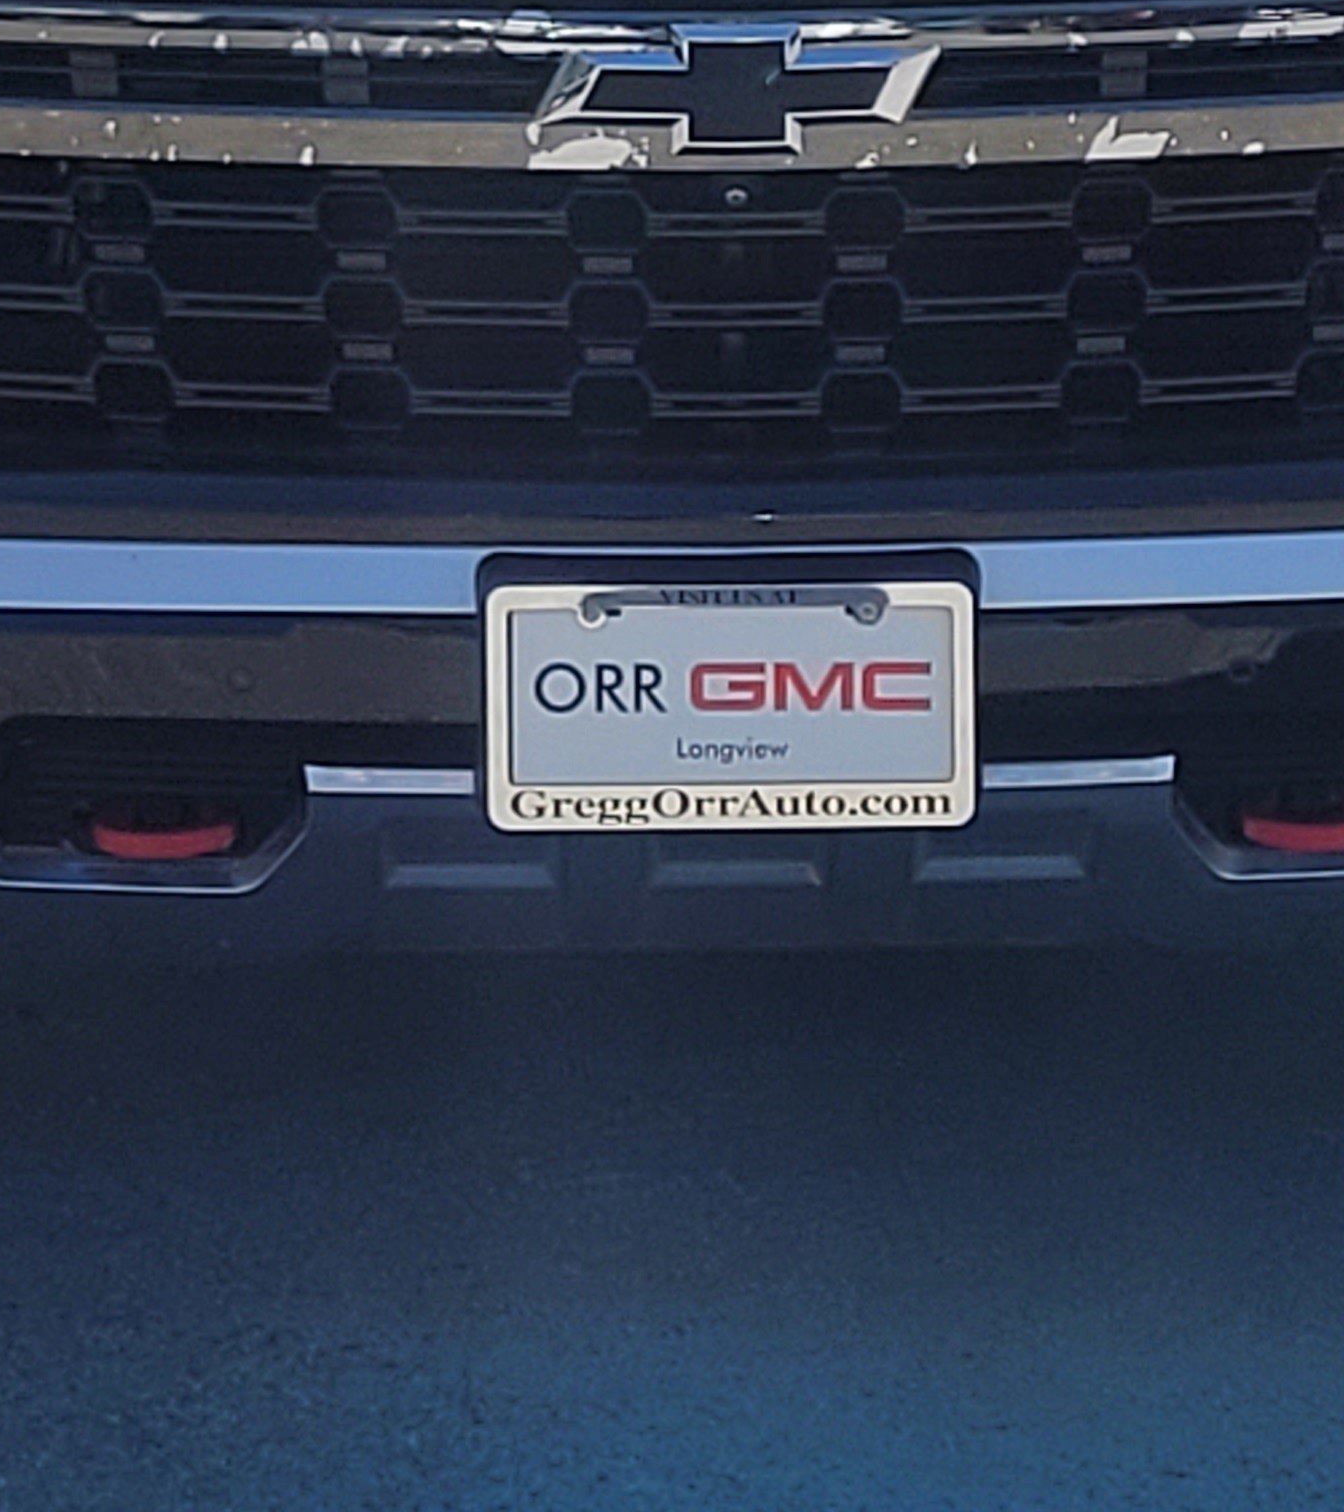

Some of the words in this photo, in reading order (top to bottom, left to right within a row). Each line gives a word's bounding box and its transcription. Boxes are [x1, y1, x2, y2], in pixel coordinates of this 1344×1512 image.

[534, 661, 668, 714] ORR
[690, 661, 933, 711] GMC
[676, 737, 790, 764] Longview
[510, 788, 953, 826] GreggOrrAuto.com
